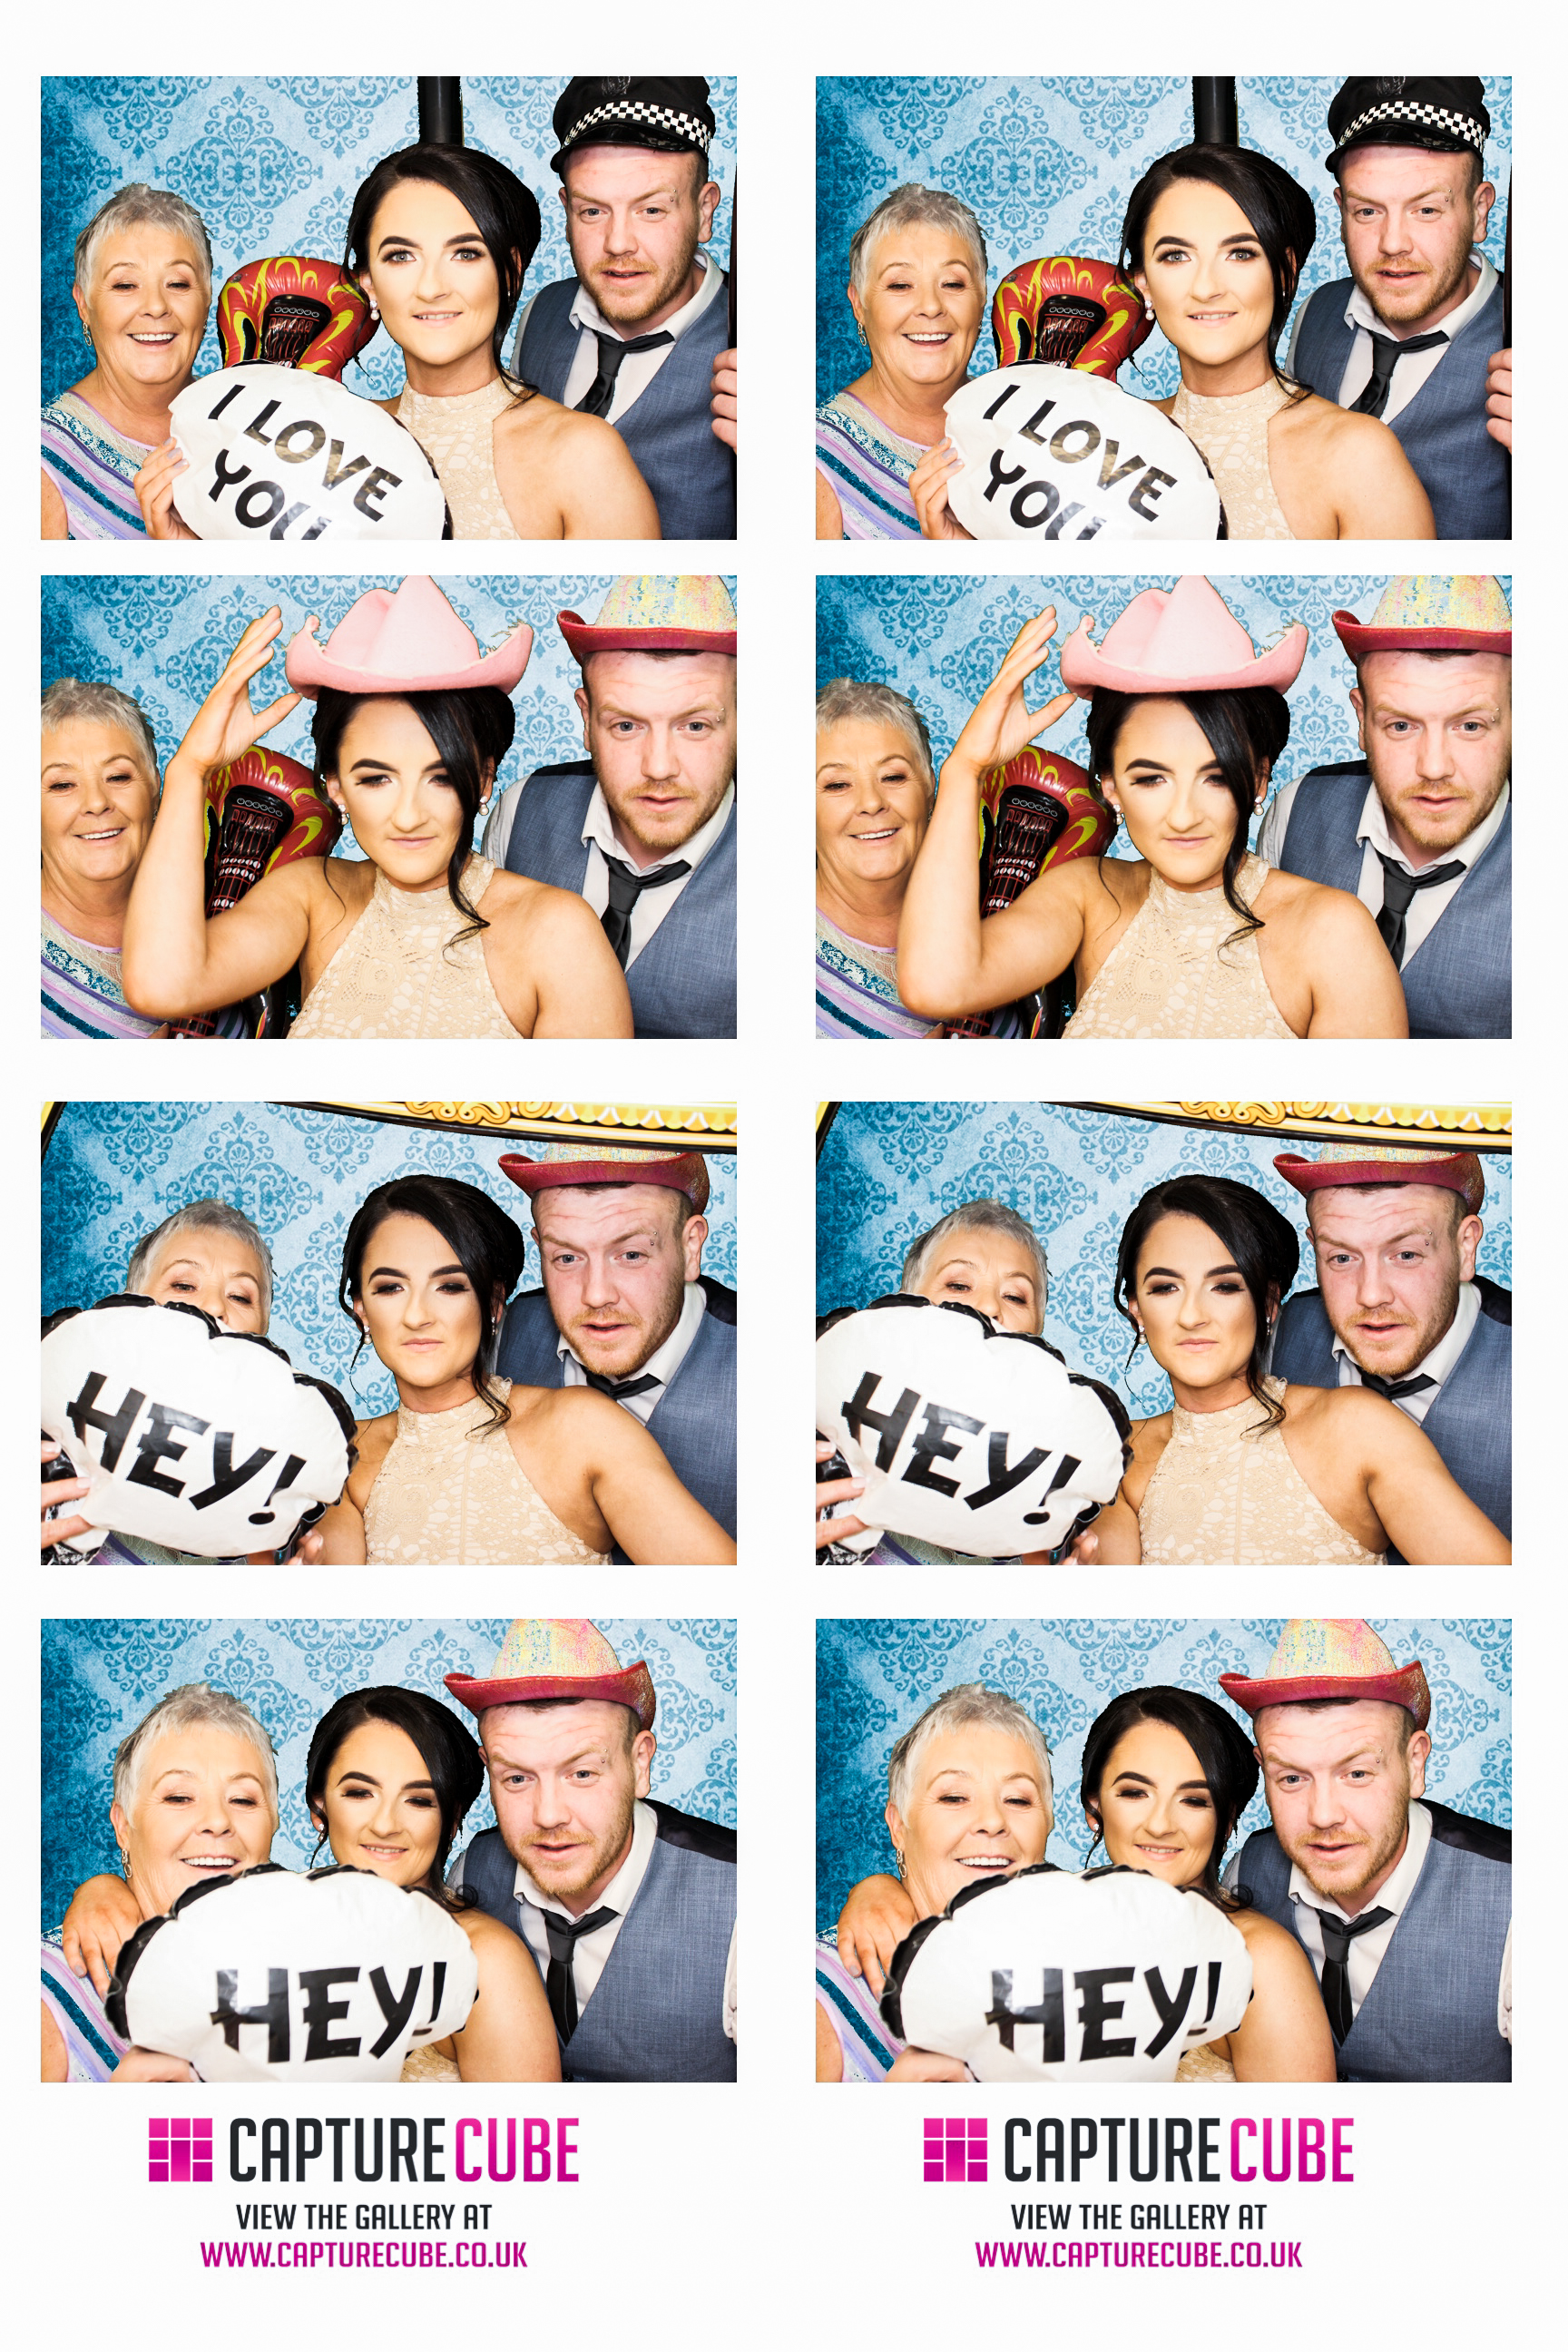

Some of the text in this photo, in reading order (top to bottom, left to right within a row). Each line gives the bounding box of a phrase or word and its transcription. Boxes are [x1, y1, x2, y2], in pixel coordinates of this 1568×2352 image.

[208, 385, 403, 522] I LOVE
[208, 448, 332, 540] YOU
[983, 385, 1178, 522] I LOVE
[983, 448, 1107, 540] YOU
[66, 1371, 307, 1524] HEY!
[841, 1371, 1082, 1524] HEY!
[210, 1962, 446, 2063] HEY!
[985, 1962, 1221, 2063] HEY!
